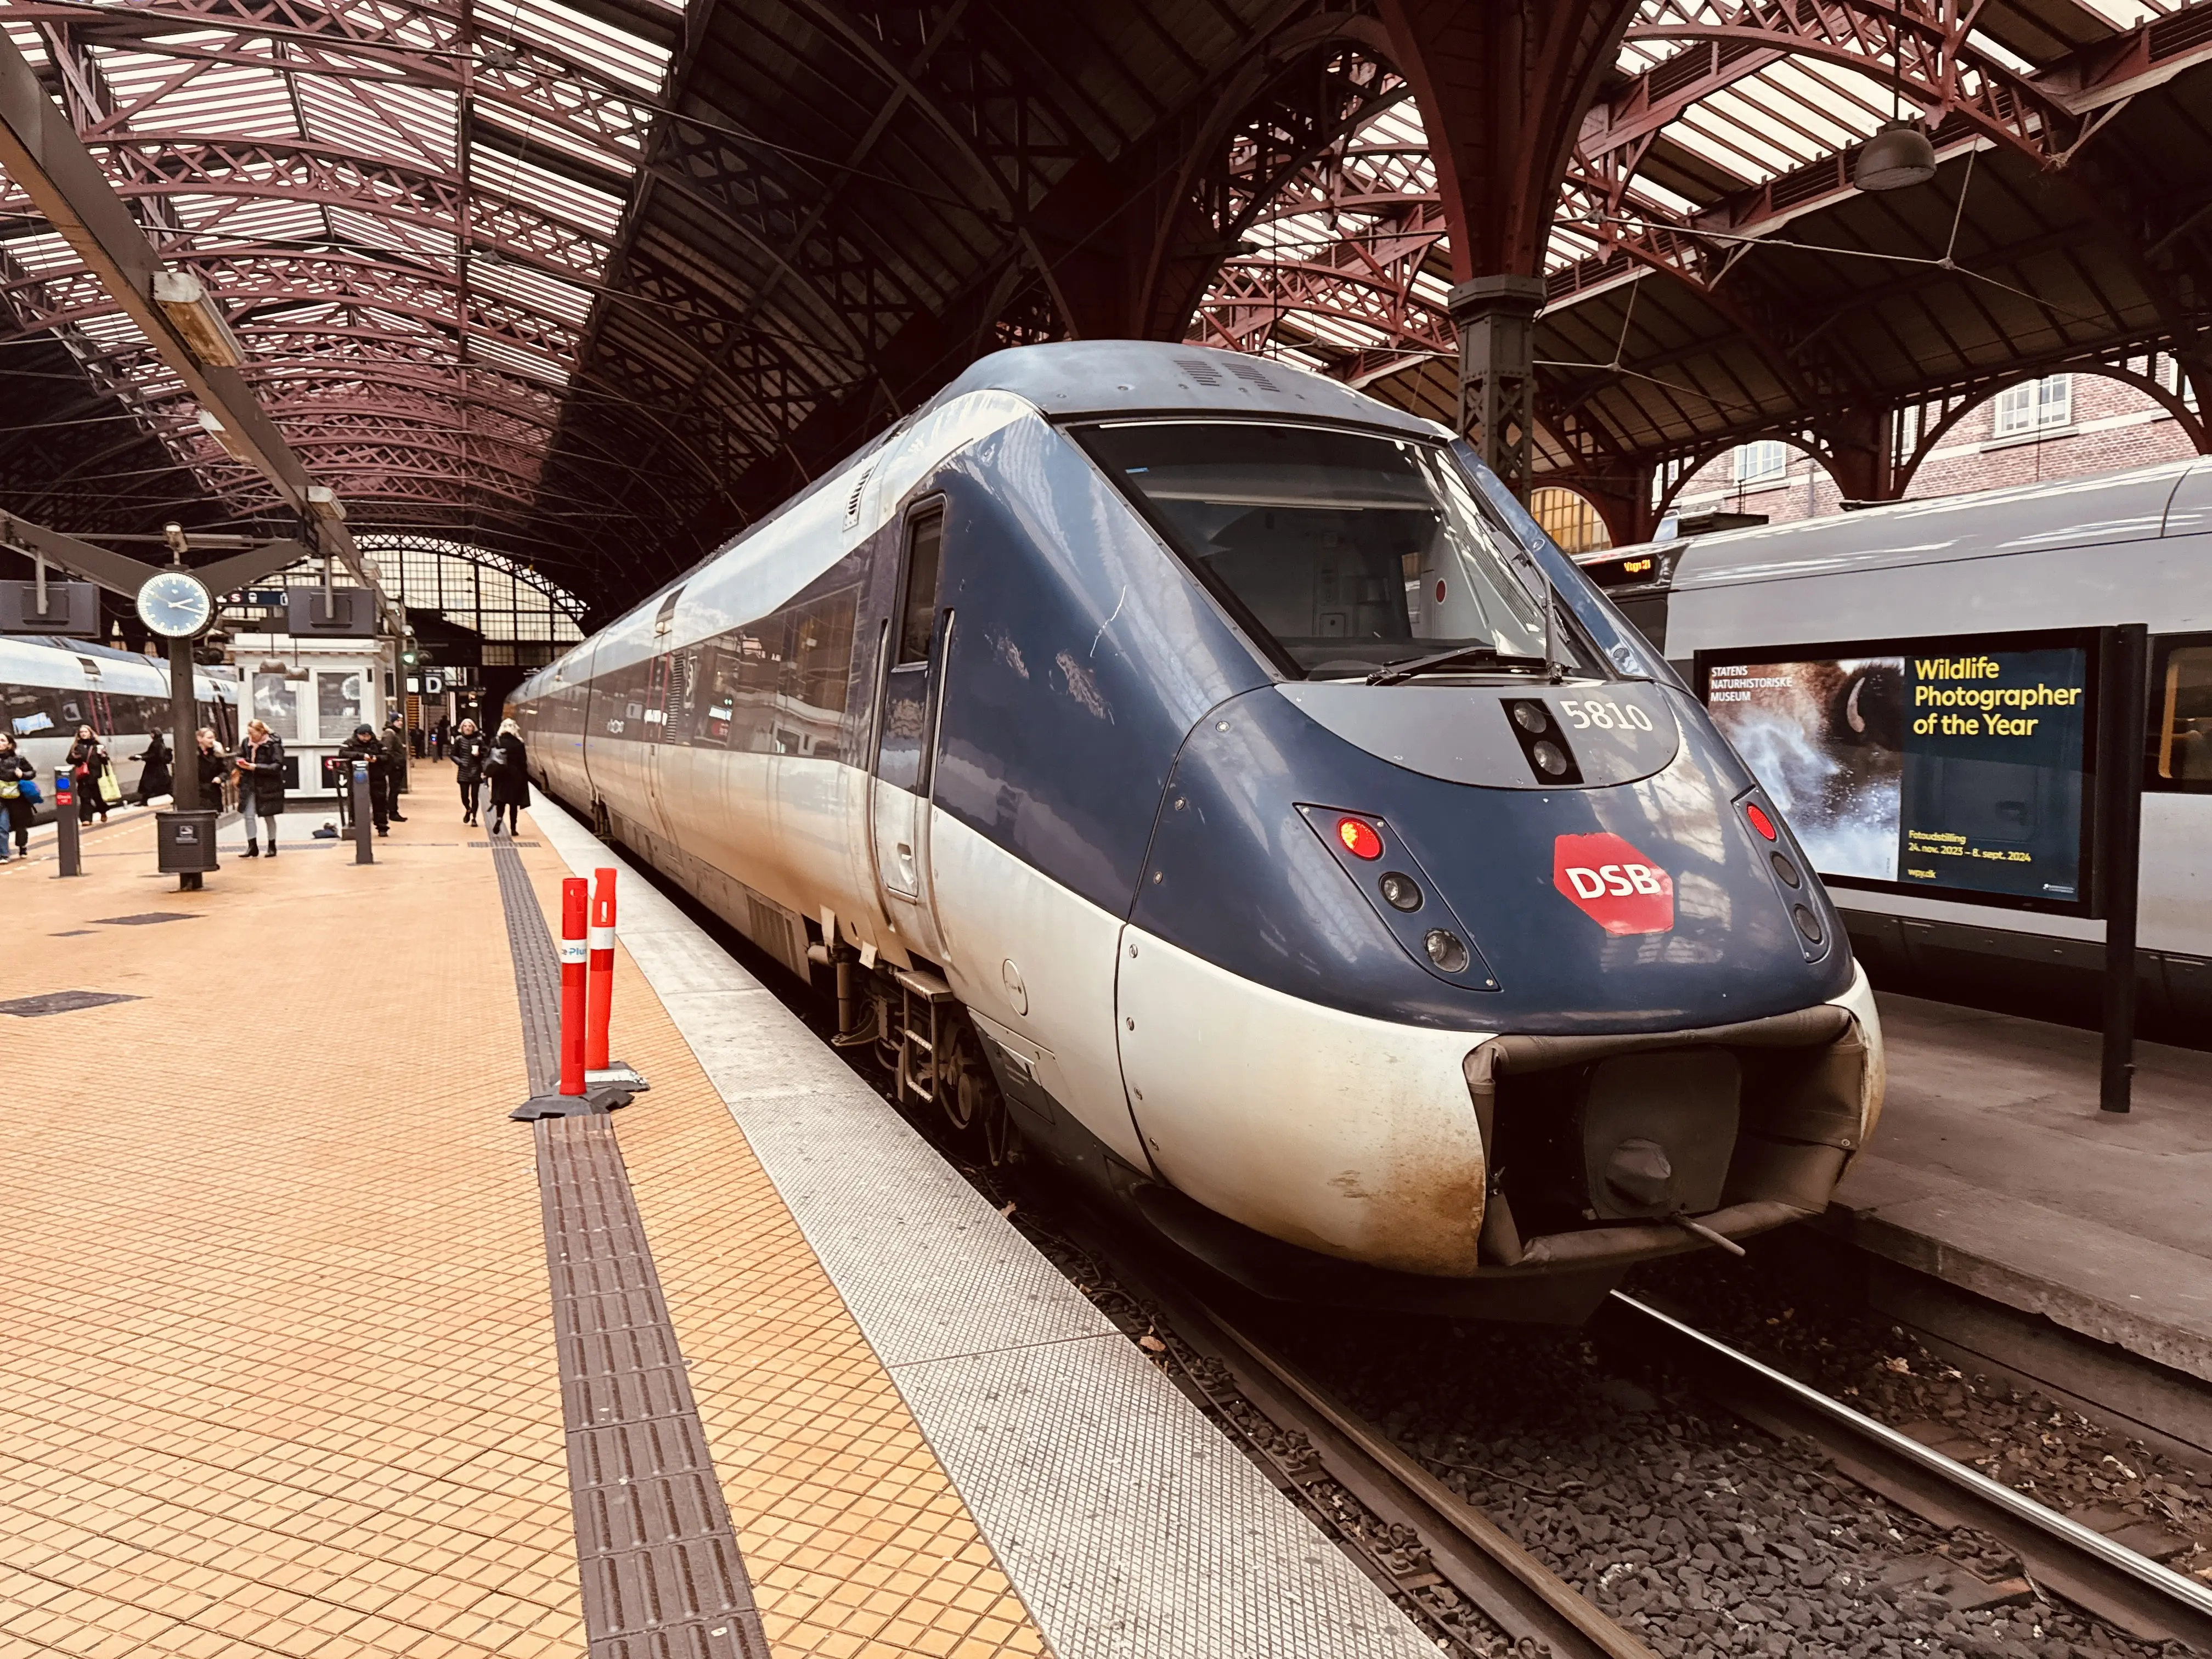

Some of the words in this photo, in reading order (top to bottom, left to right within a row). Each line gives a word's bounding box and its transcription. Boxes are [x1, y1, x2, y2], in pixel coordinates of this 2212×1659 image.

[1711, 665, 1748, 676] STATENS
[1915, 656, 2000, 680] Wildlife
[425, 676, 442, 693] D
[1711, 677, 1792, 689] NATURHISTORISKE
[1711, 691, 1751, 701] MUSEUM
[1915, 684, 2082, 710] Photographer
[1560, 701, 1653, 731] 5810
[1914, 713, 1938, 735] of
[1940, 713, 1979, 735] the
[1982, 714, 2039, 736] Year
[1909, 830, 1966, 845] Fotoudstilling
[1908, 842, 1921, 851] 24.
[1921, 845, 1939, 854] nov.
[1940, 845, 1963, 856] 2023
[1972, 848, 1982, 857] 8.
[1982, 851, 2007, 861] sept.
[2007, 851, 2032, 862] 2024
[1565, 864, 1661, 899] DSB
